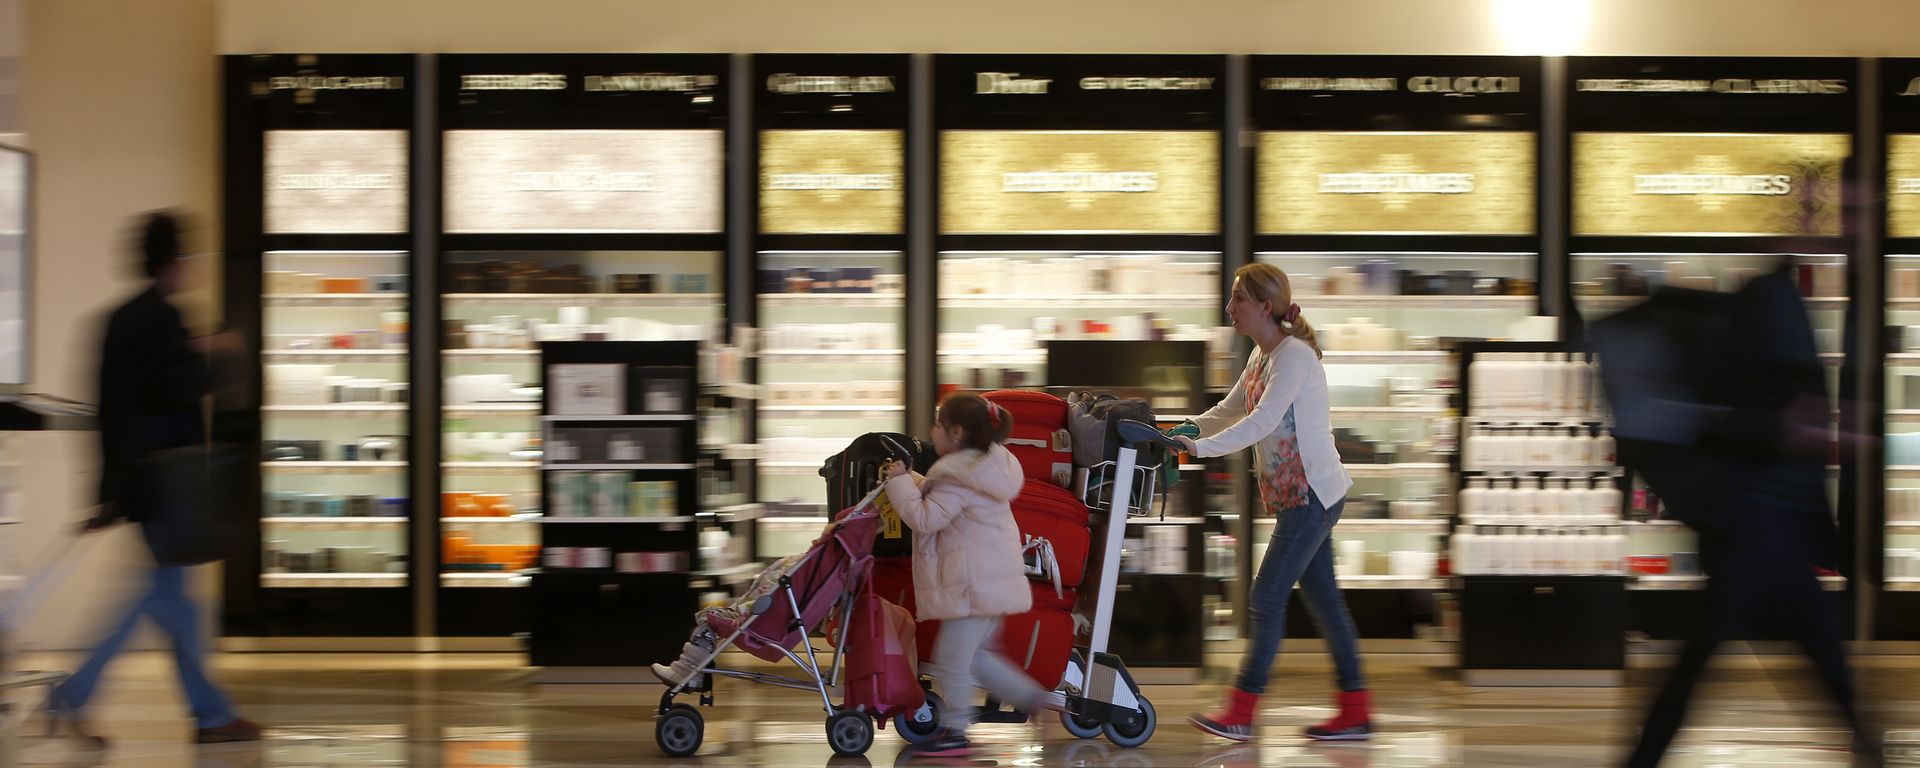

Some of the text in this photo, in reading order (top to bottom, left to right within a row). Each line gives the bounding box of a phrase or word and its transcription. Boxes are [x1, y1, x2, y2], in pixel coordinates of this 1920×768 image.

[975, 72, 1053, 94] Dior
[1001, 171, 1159, 193] PERFUMES
[1318, 173, 1475, 194] PERFUMES
[1633, 174, 1791, 195] PERFUMES
